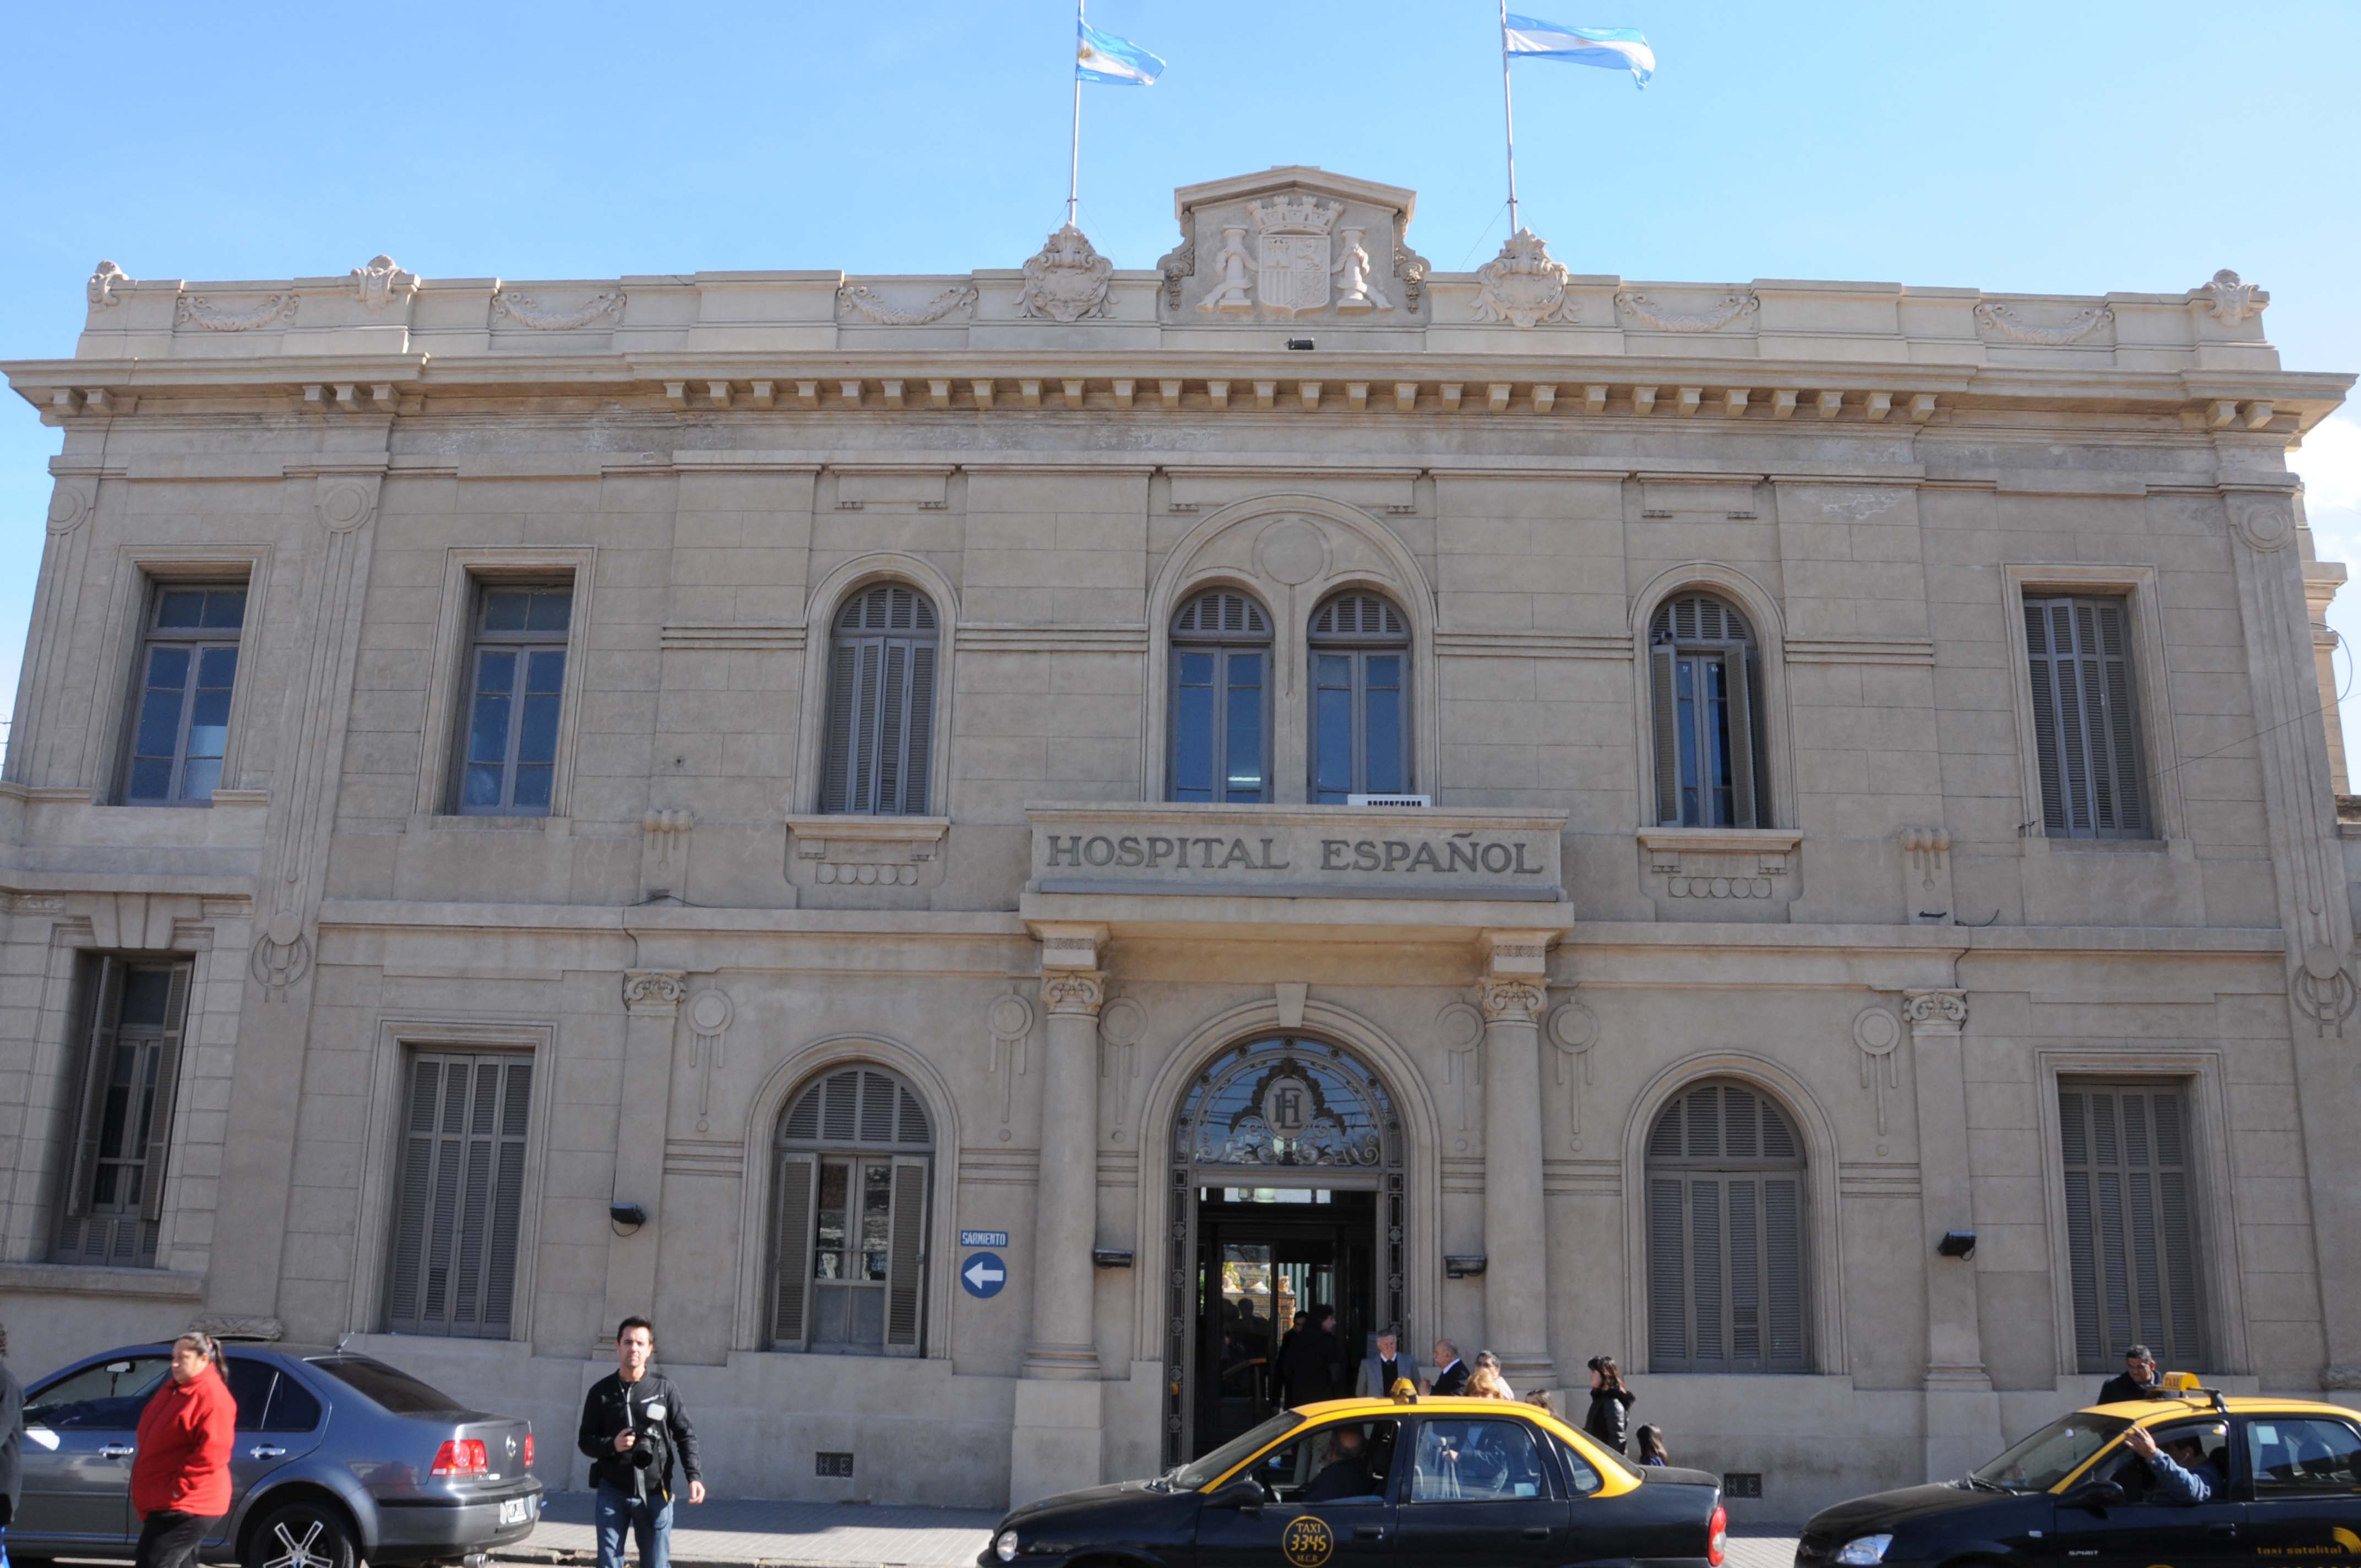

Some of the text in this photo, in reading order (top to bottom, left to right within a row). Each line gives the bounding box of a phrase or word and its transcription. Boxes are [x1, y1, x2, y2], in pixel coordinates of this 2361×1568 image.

[1047, 831, 1543, 874] HOSPITAL ESPAÑOL
[962, 1232, 1005, 1245] SARMIENTO
[2164, 1377, 2180, 1386] TAXI
[1296, 1523, 1321, 1533] TAXI
[1290, 1534, 1327, 1552] 3345
[2257, 1545, 2342, 1554] taxi satelital
